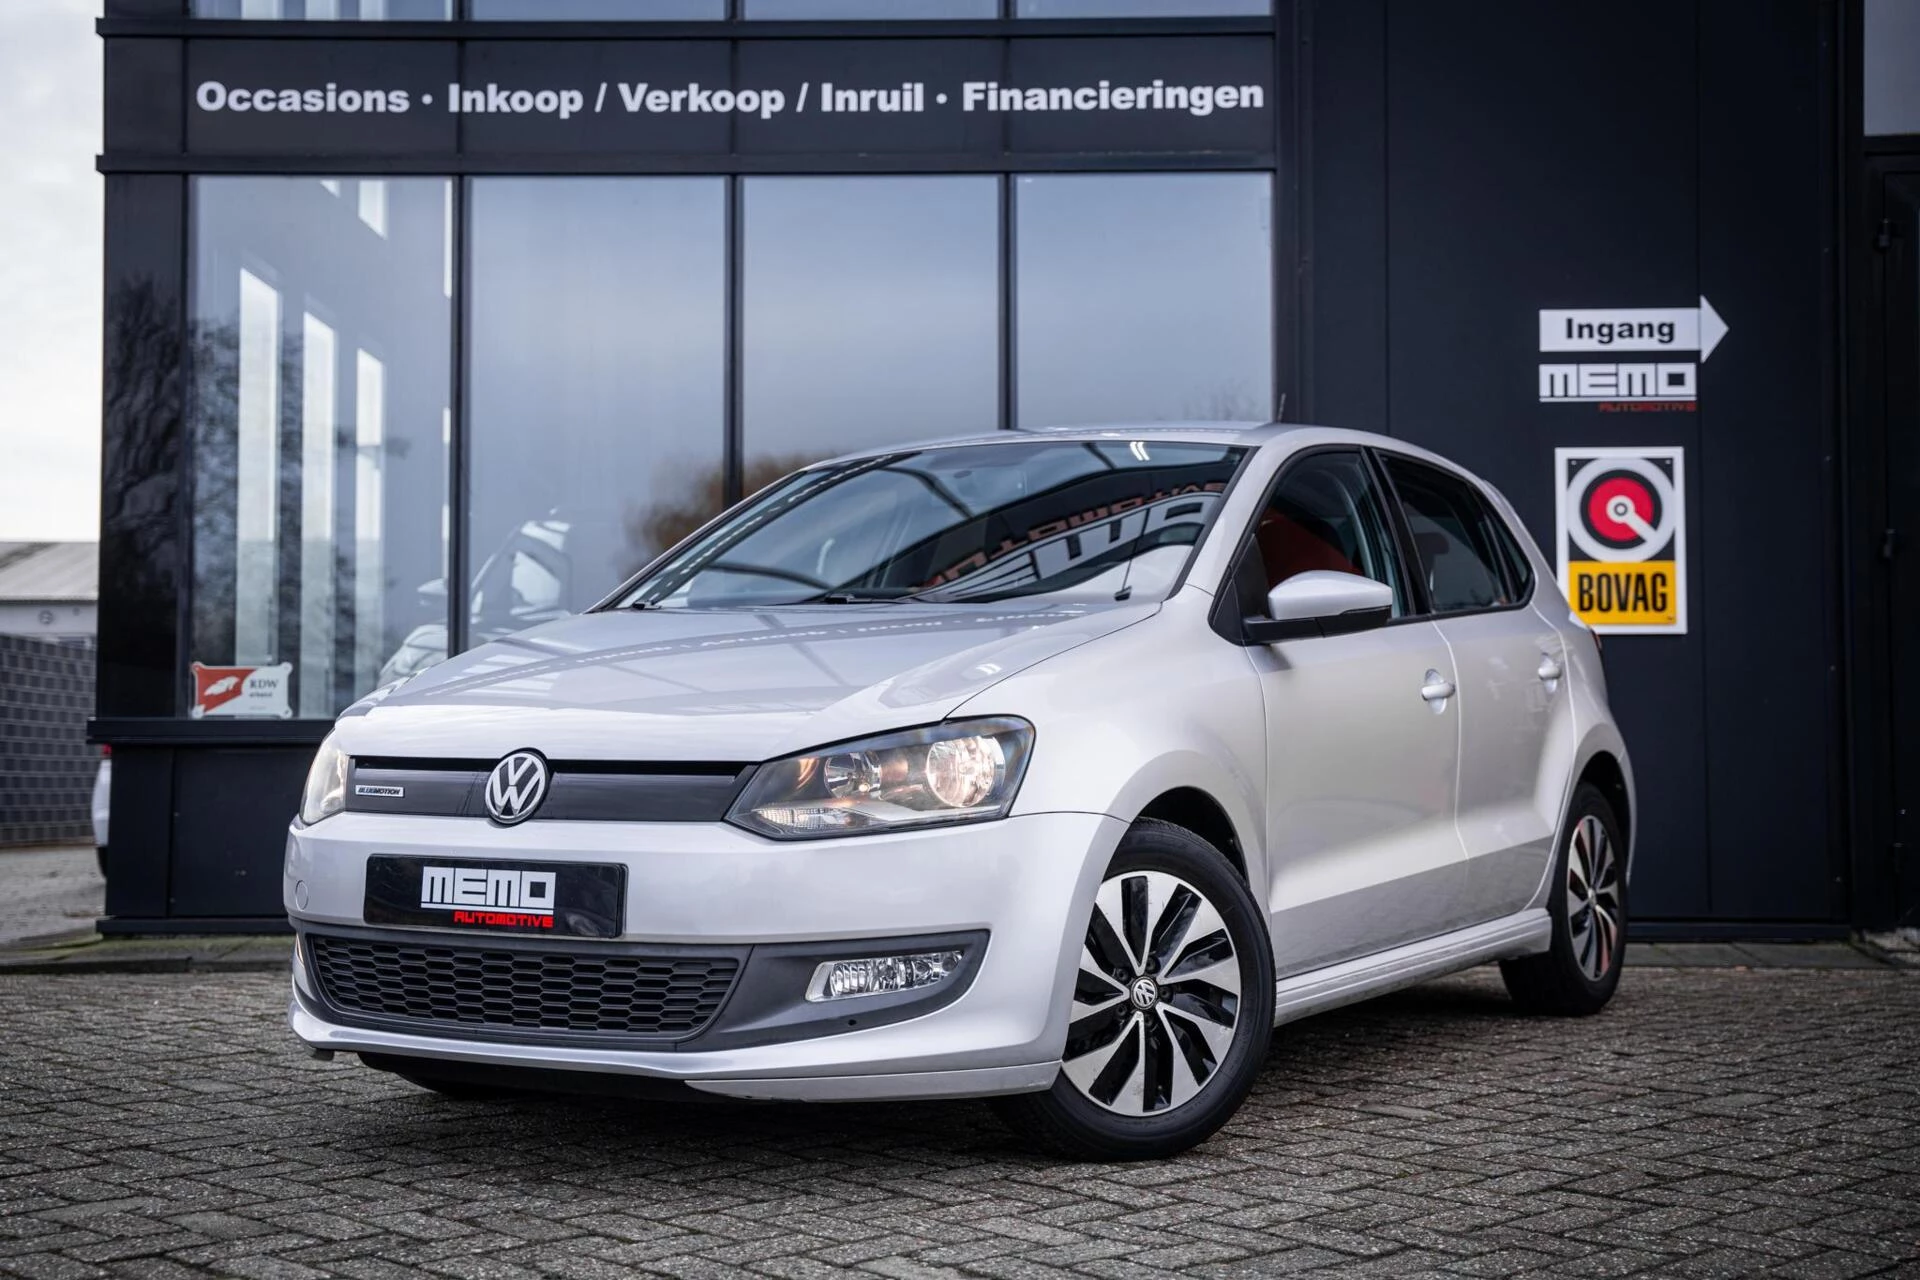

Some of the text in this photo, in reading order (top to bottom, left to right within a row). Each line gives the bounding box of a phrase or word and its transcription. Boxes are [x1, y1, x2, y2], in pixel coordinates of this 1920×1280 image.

[197, 82, 409, 112] Occasions
[449, 84, 583, 119] Inkoop
[618, 83, 785, 119] Verkoop
[821, 83, 924, 112] Inruil
[963, 80, 1263, 116] Financieringen
[1567, 319, 1674, 344] Ingang
[1539, 363, 1696, 397] MEMO
[1579, 573, 1666, 612] BOVAG
[421, 866, 556, 908] MEMO
[455, 912, 552, 927] AUTOMOTIVE
